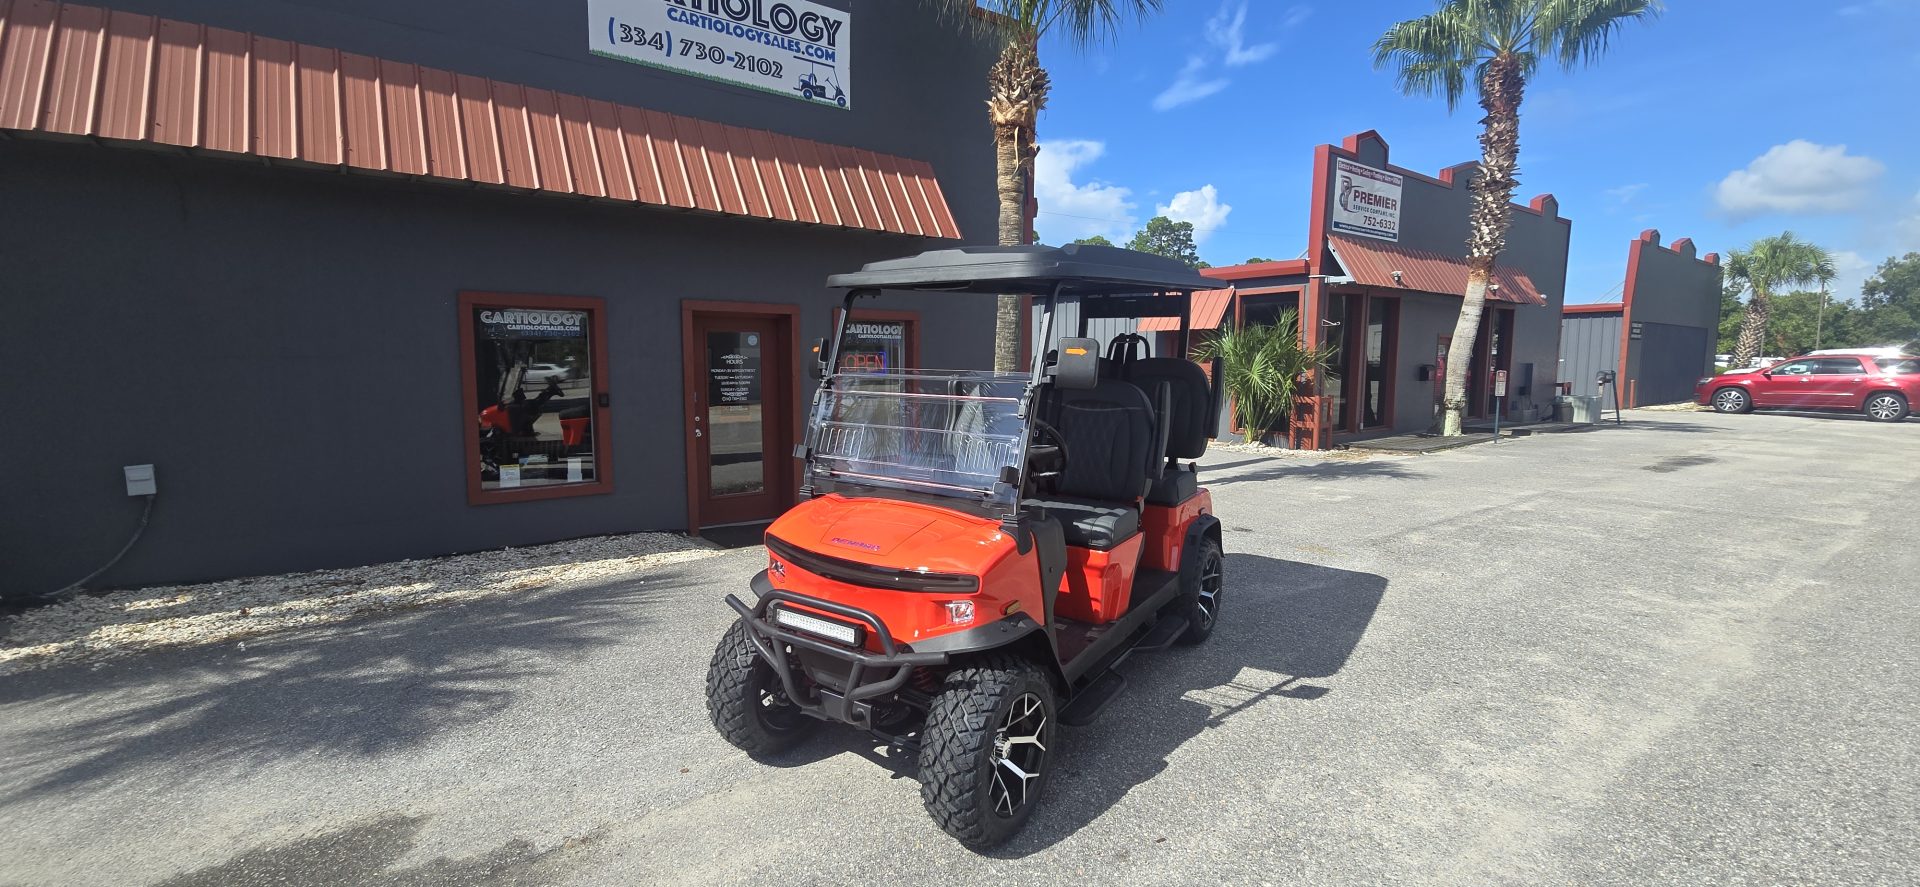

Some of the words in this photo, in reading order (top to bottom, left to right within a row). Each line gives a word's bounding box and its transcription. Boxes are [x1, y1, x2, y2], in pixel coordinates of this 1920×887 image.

[664, 0, 843, 47] IOLOGY
[667, 7, 836, 62] CARTIOLOGYSALES.COM
[608, 17, 673, 57] (334)
[680, 38, 783, 78] 730-2102
[1353, 190, 1398, 211] PREMIER
[1353, 204, 1370, 212] SERVICE
[1363, 216, 1396, 230] 752-6332
[481, 311, 582, 325] CARTIOLOGY
[845, 354, 884, 371] OPEN
